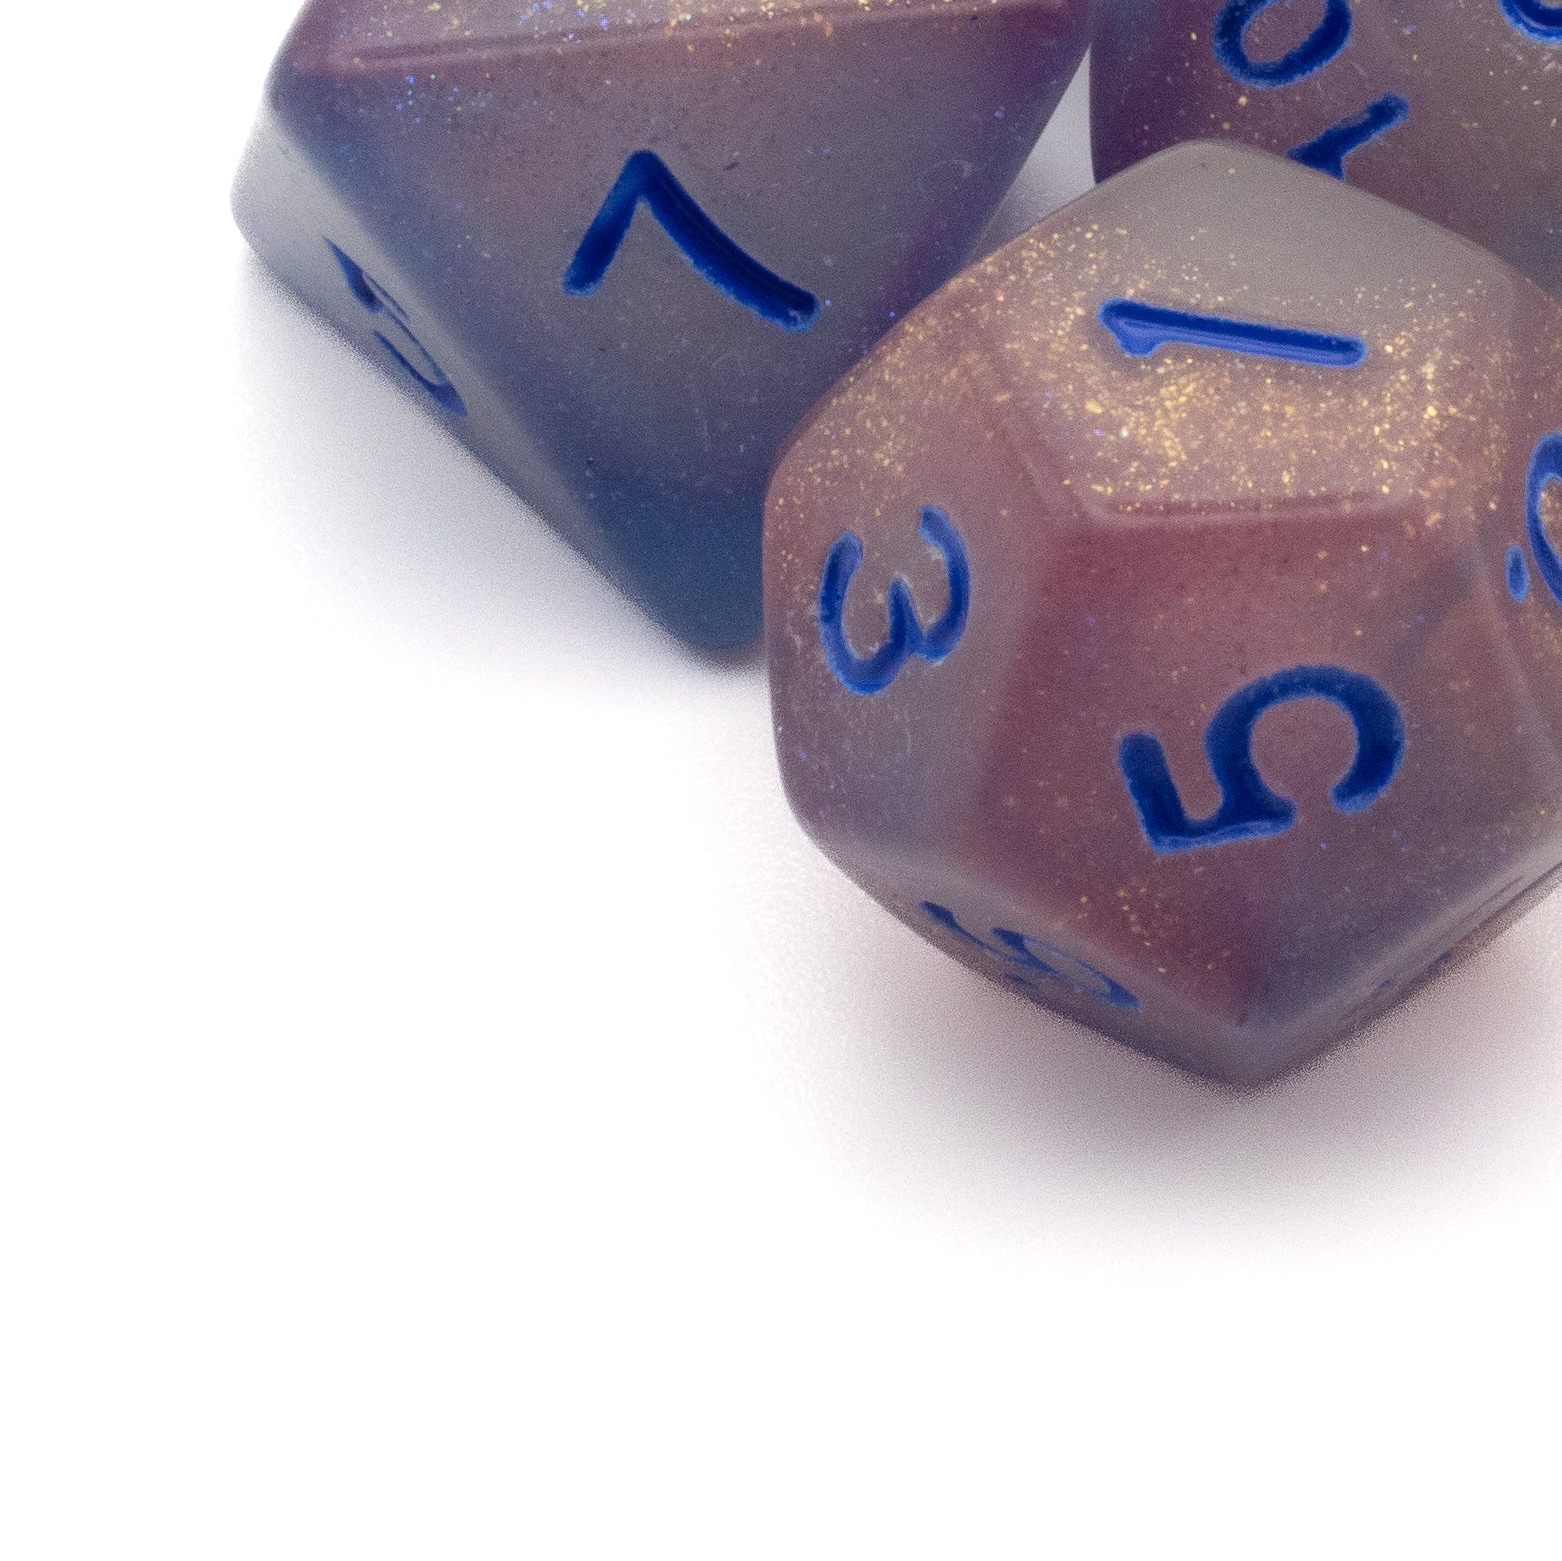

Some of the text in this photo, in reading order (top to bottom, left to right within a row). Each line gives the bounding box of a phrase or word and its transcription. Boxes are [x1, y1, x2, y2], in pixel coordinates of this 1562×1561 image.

[561, 149, 821, 333] 7
[1098, 296, 1369, 370] 1
[818, 503, 974, 696] 3
[1116, 664, 1406, 856] 5
